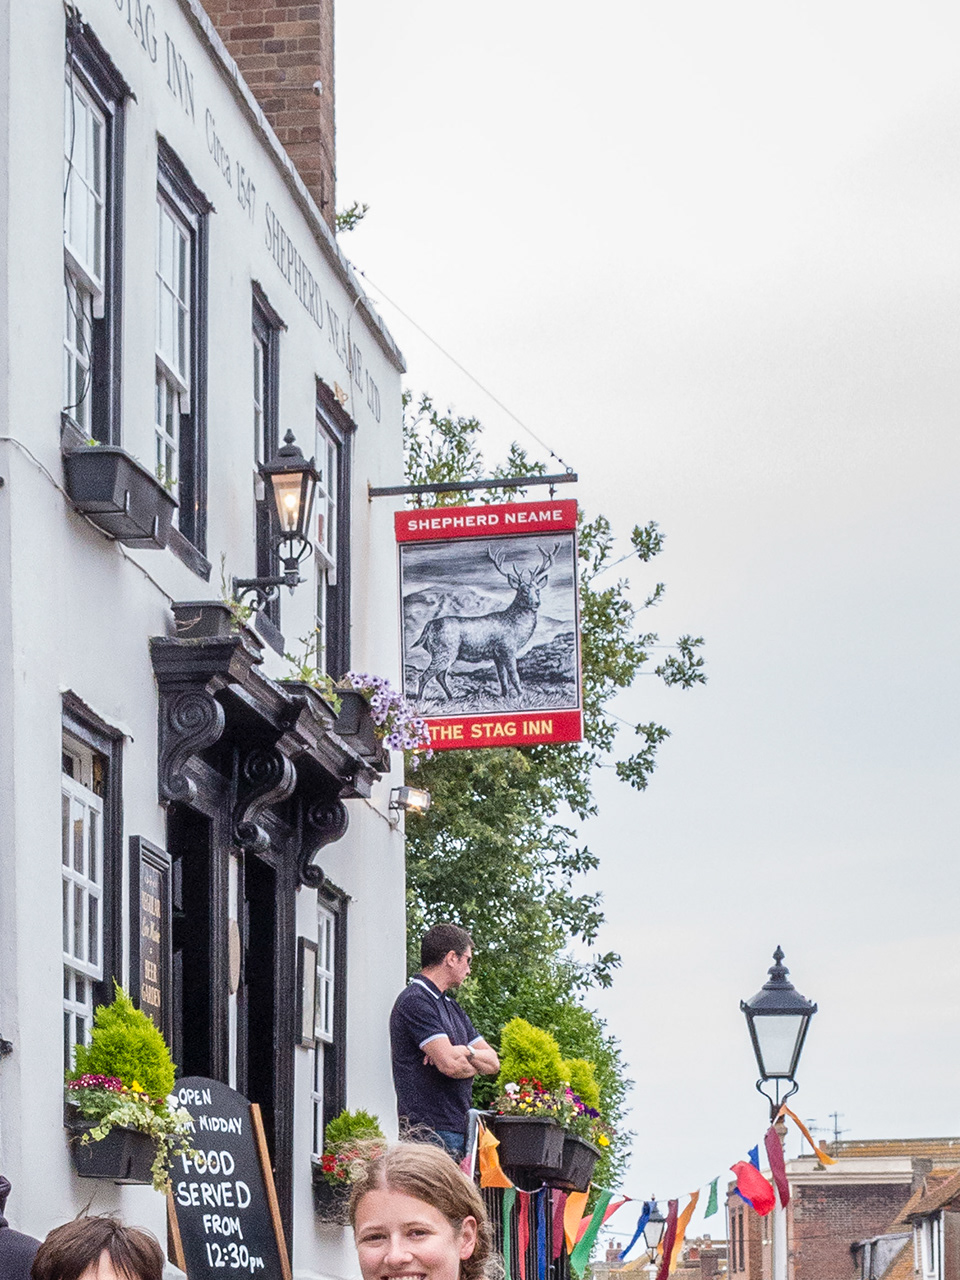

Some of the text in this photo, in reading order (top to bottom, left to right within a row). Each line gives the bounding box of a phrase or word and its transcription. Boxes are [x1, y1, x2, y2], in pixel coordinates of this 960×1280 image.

[115, 0, 195, 125] TAG INN
[205, 108, 256, 225] Circa 1547
[265, 202, 324, 330] SHEPHERD
[365, 369, 381, 424] LTD
[407, 509, 563, 531] SHEPHERD NEAME
[429, 720, 553, 740] THE STAG INN
[178, 1088, 212, 1106] OPEN
[199, 1115, 242, 1135] MIDDAY
[182, 1150, 235, 1176] FOOD
[177, 1181, 251, 1208] SERVED
[203, 1214, 243, 1240] FROM
